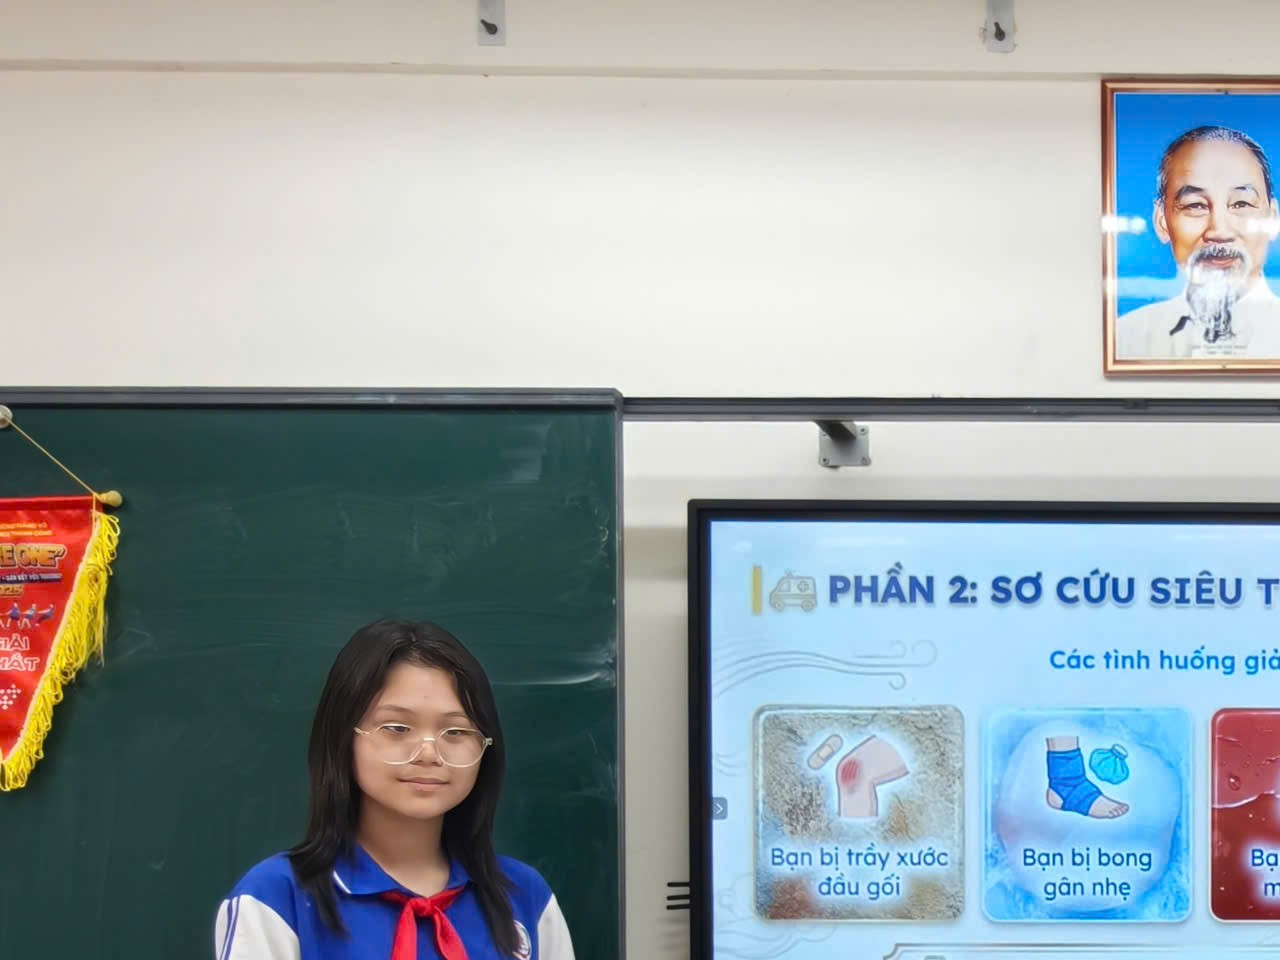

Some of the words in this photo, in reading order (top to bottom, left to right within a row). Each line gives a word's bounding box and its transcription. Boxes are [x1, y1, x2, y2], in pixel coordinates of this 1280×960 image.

[829, 562, 934, 604] PHẦN
[948, 575, 978, 604] 2:
[990, 571, 1043, 605] SƠ
[1055, 568, 1135, 605] CỨU
[1150, 570, 1243, 605] SIÊU
[0, 633, 30, 651] IẢI
[1049, 648, 1095, 671] Các
[1103, 648, 1150, 671] tình
[1159, 645, 1236, 676] huống
[771, 847, 813, 871] Bạn
[820, 846, 840, 871] bị
[846, 842, 889, 872] trầy
[897, 846, 948, 867] xước
[1023, 848, 1064, 872] Bạn
[1071, 847, 1090, 872] bị
[1098, 847, 1153, 873] bong
[818, 873, 860, 896] đầu
[867, 872, 901, 902] gối
[1043, 876, 1085, 902] gân
[1092, 877, 1131, 902] nhẹ
